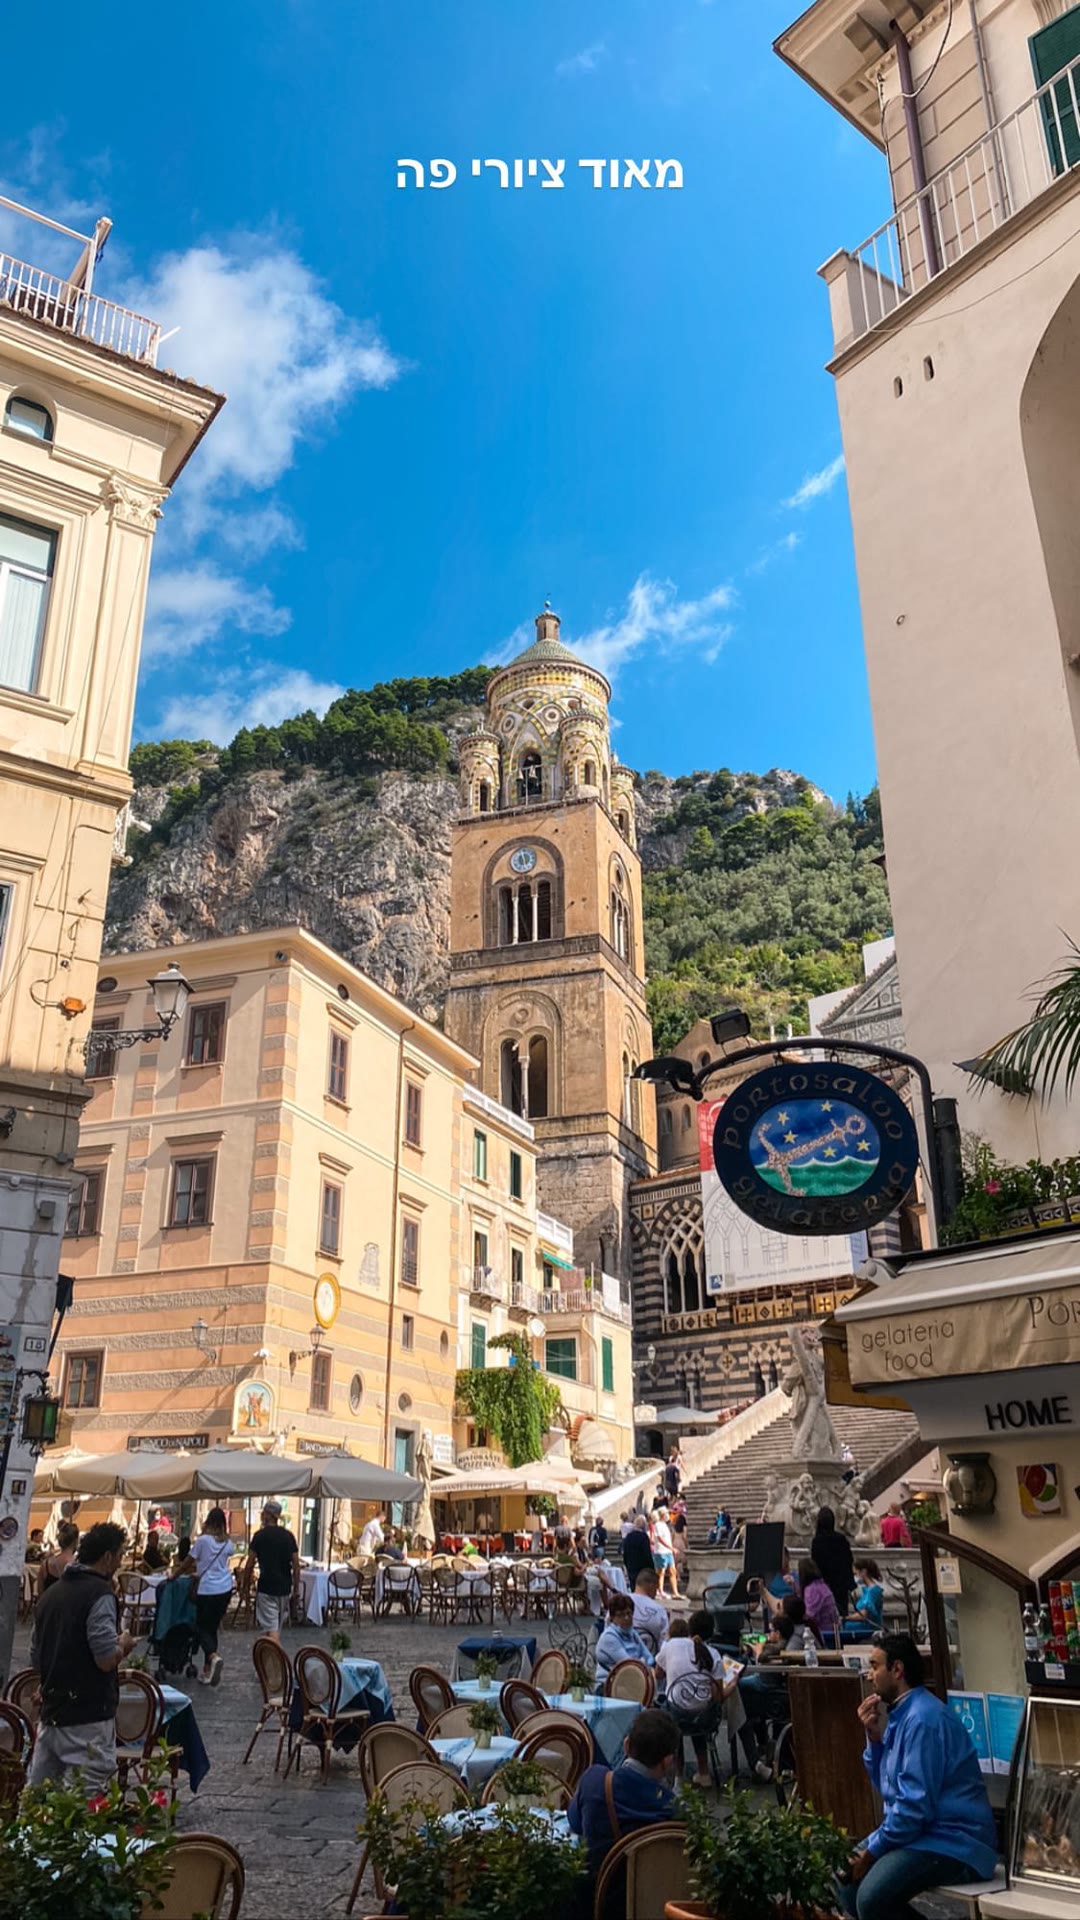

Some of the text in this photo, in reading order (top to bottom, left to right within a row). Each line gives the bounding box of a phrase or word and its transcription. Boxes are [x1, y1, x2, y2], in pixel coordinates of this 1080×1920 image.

[861, 1320, 954, 1353] gelateria
[885, 1344, 933, 1372] food
[984, 1396, 1073, 1431] HOME
